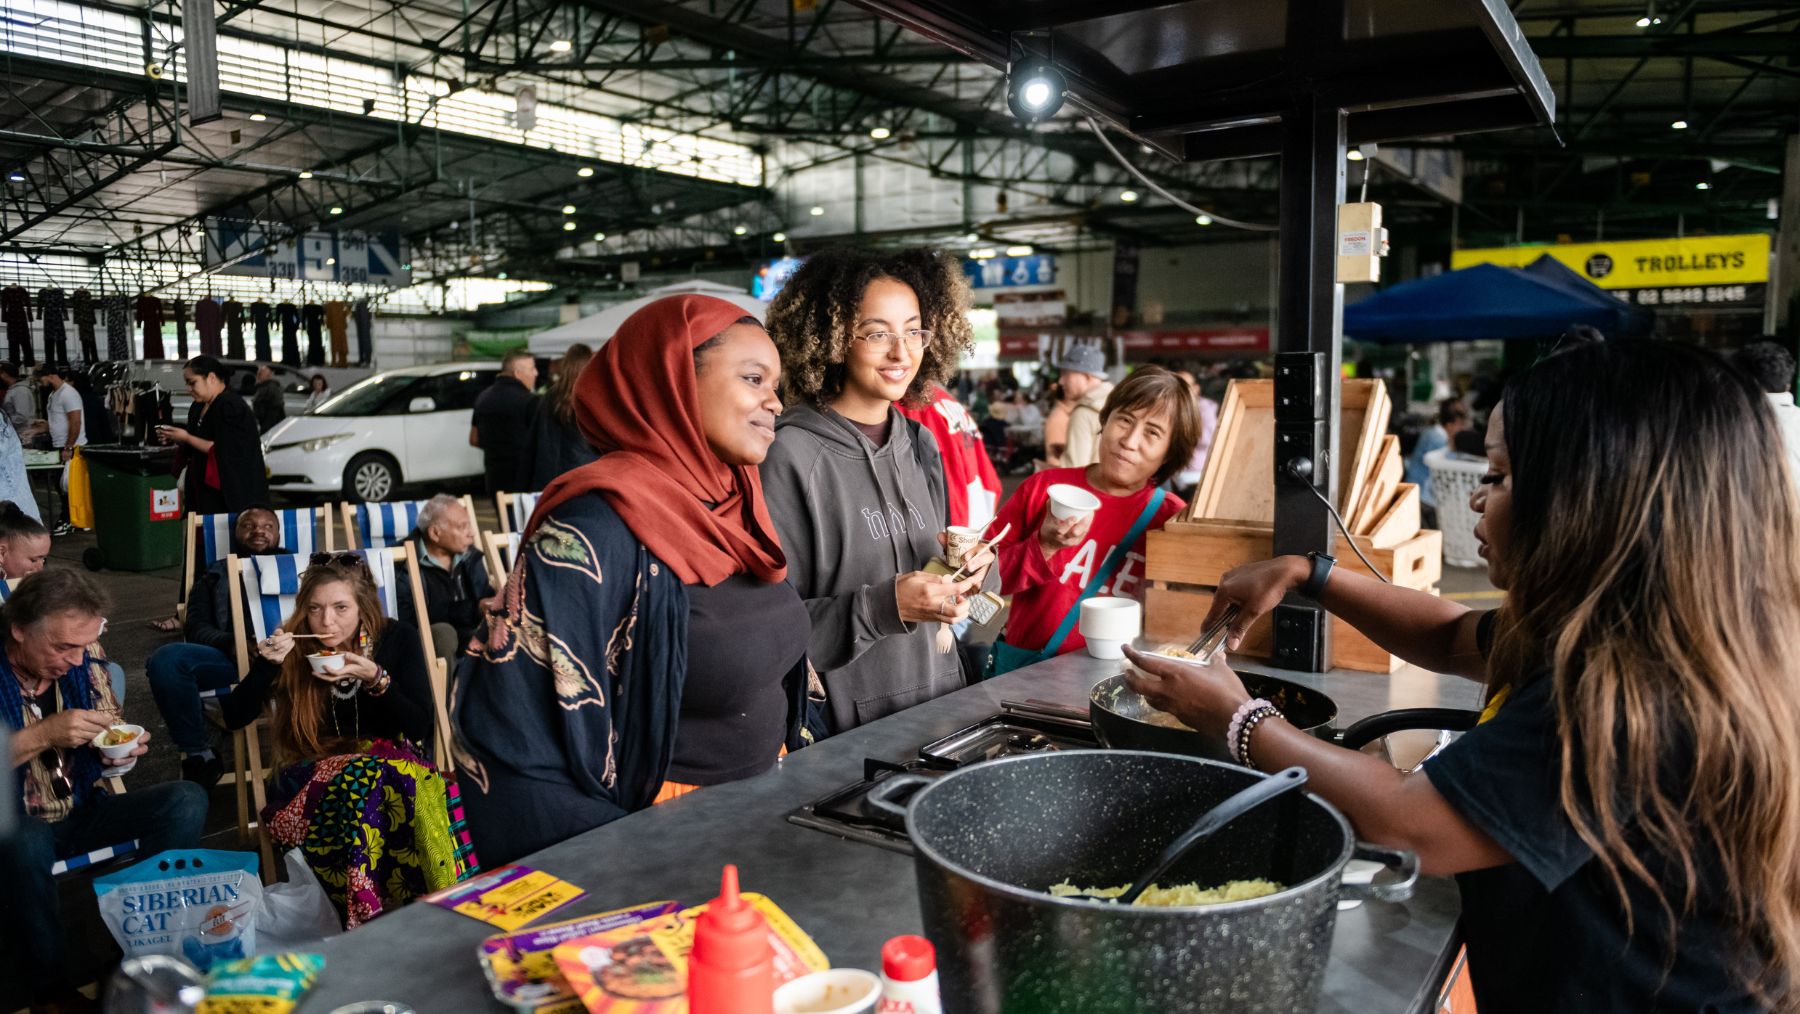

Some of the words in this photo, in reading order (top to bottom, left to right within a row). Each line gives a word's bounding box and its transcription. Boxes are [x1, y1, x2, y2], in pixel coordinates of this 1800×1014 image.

[1635, 251, 1745, 273] TROLLEYS
[123, 884, 239, 914] SIBERIAN
[122, 912, 172, 935] CAT
